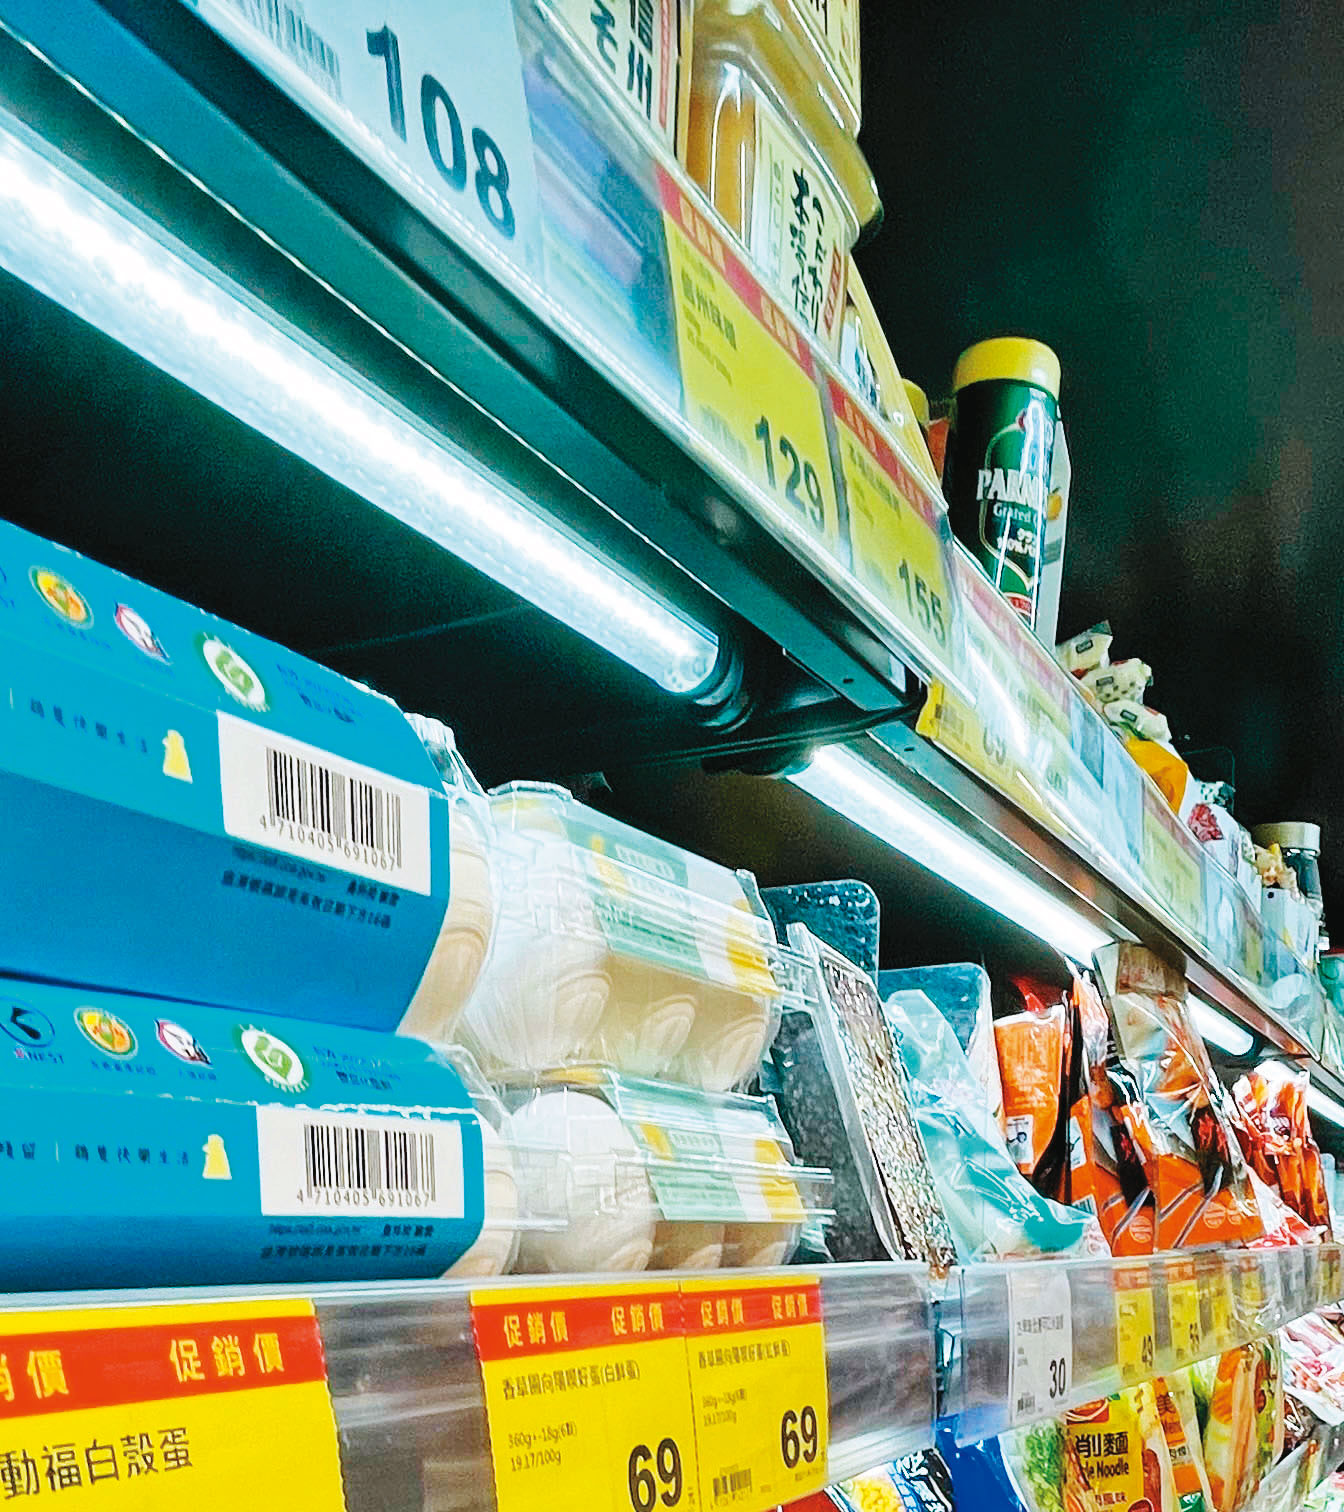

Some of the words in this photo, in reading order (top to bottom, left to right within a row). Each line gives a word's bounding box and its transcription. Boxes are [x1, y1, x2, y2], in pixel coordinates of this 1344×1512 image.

[366, 24, 516, 241] 108
[755, 414, 825, 534] 129
[898, 557, 946, 651] 155
[277, 825, 335, 855] 710405
[344, 842, 397, 873] 691067
[314, 1187, 370, 1206] 710405
[378, 1189, 431, 1207] 691067
[503, 1311, 568, 1349] 促銷價
[611, 1303, 665, 1336] 促銷價
[169, 1331, 285, 1383] 促銷價
[1049, 1357, 1067, 1400] 30
[781, 1405, 818, 1469] 69
[1096, 1461, 1129, 1480] Noodle
